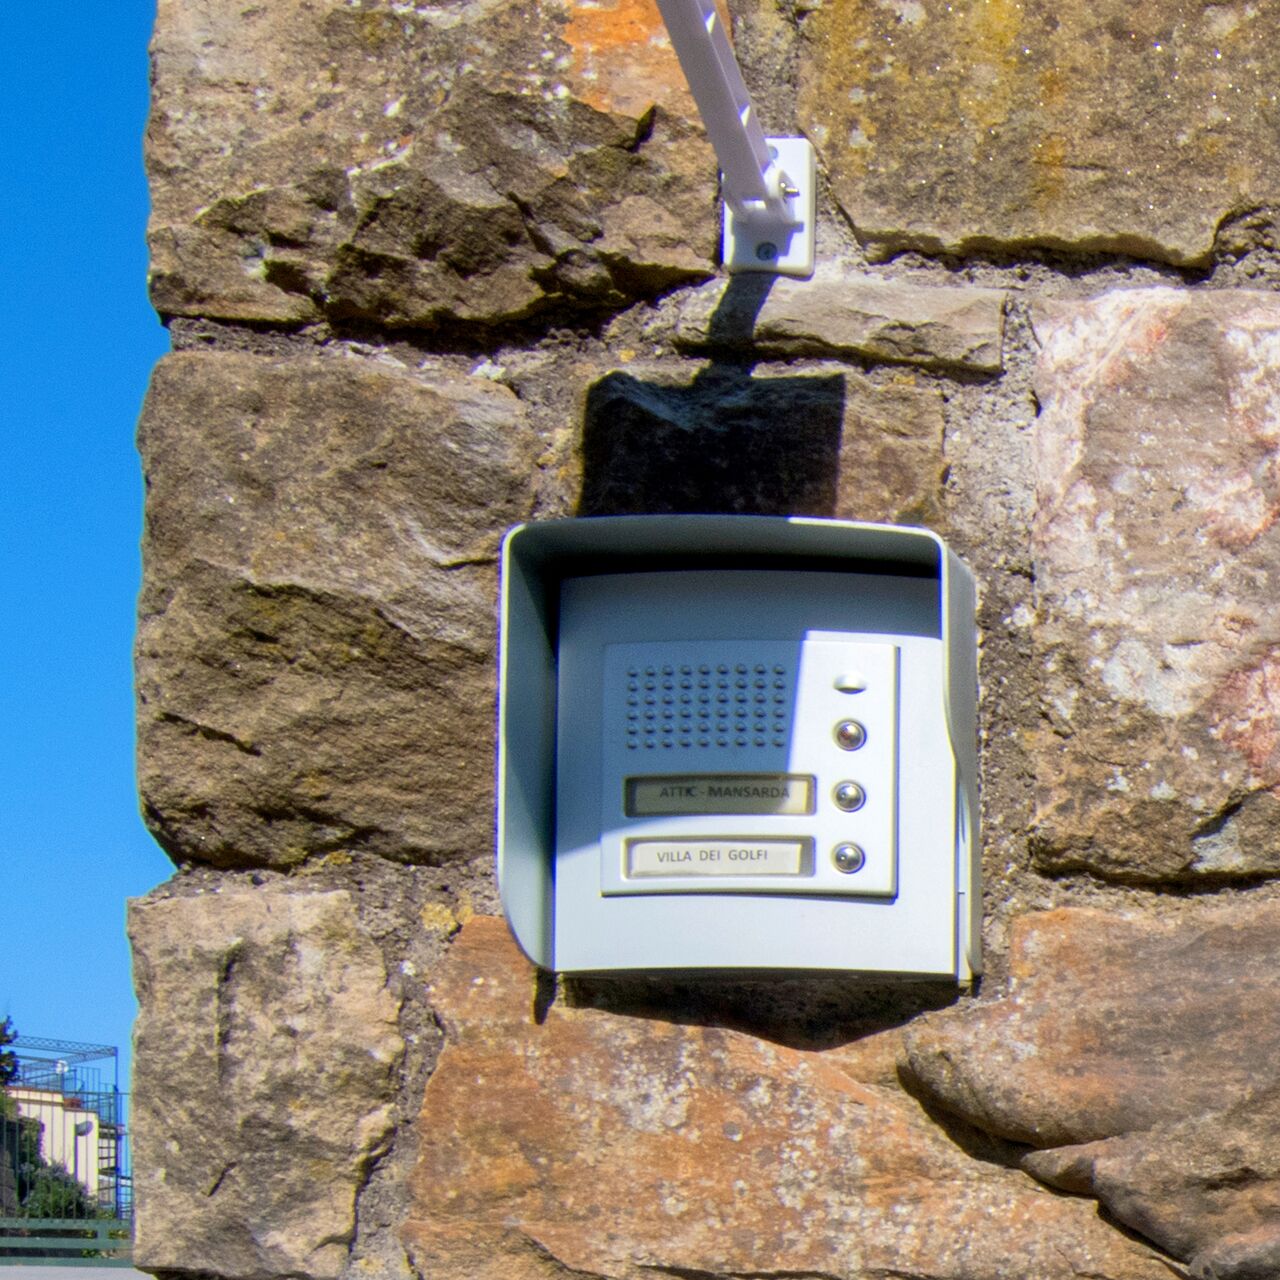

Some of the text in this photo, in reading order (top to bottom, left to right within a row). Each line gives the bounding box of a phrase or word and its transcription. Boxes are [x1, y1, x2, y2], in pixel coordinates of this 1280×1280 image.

[659, 786, 695, 799] ATTIC
[708, 785, 790, 799] MANSARDA
[657, 849, 768, 863] VILLA DEI GOLFI
